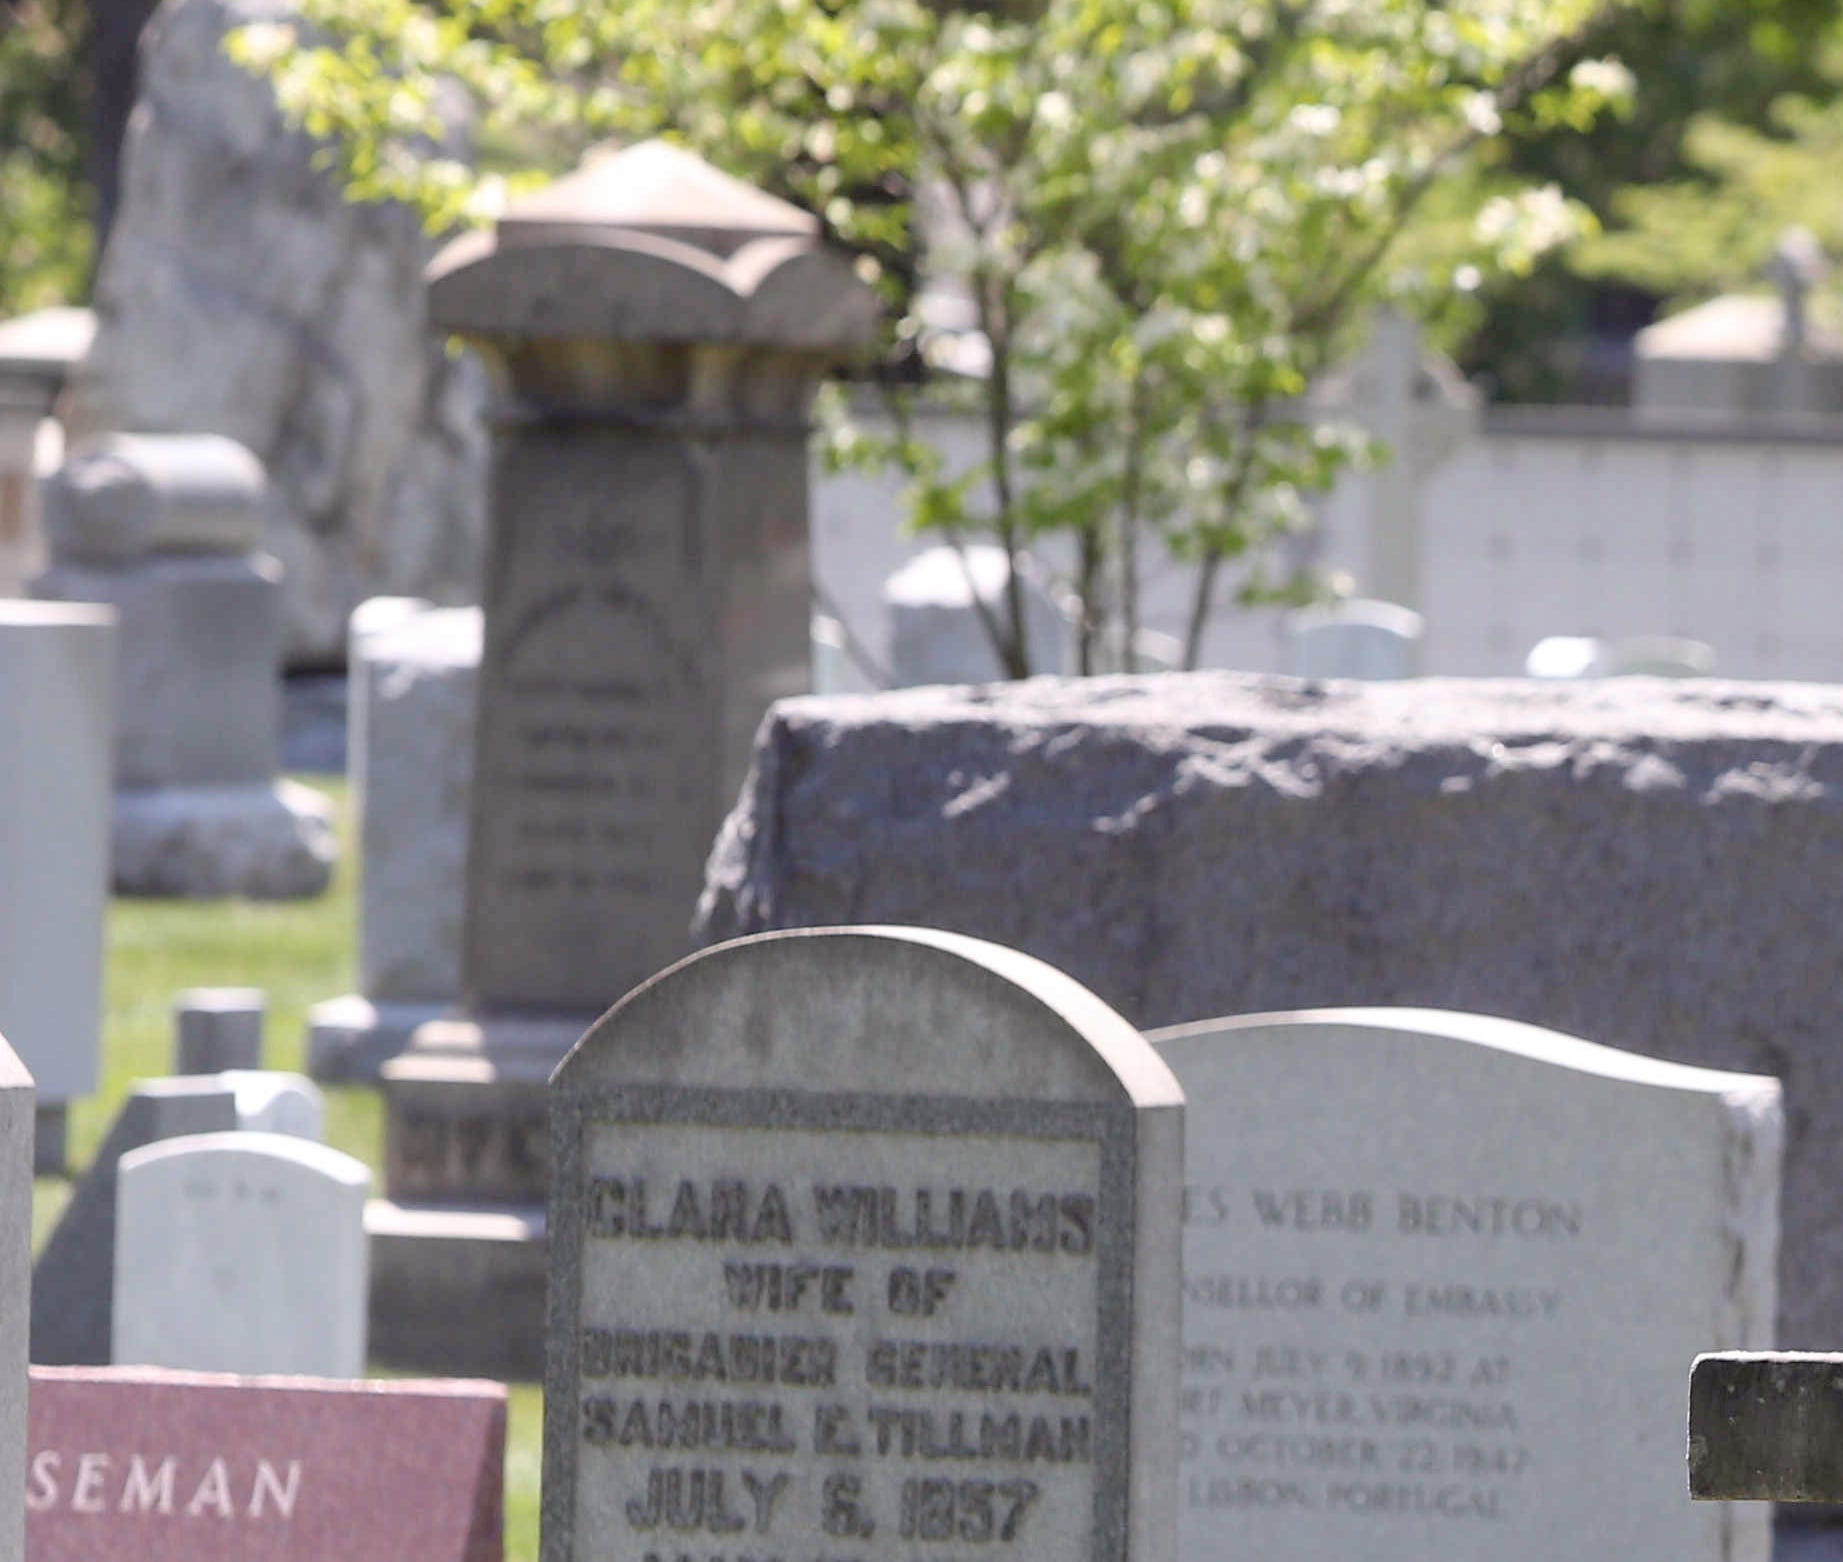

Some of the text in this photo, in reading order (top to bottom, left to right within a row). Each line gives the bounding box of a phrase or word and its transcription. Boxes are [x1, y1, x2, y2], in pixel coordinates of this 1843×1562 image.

[591, 1176, 1094, 1256] CLARA WILLIAMS
[1252, 1188, 1374, 1234] WEBB
[1398, 1192, 1582, 1241] BENTON
[724, 1261, 956, 1317] WIFE OF
[582, 1328, 1091, 1395] BRIGADIER GENERAL
[582, 1398, 796, 1452] SAMUEL
[868, 1409, 1092, 1463] TILLMAN
[625, 1467, 792, 1534] JULY
